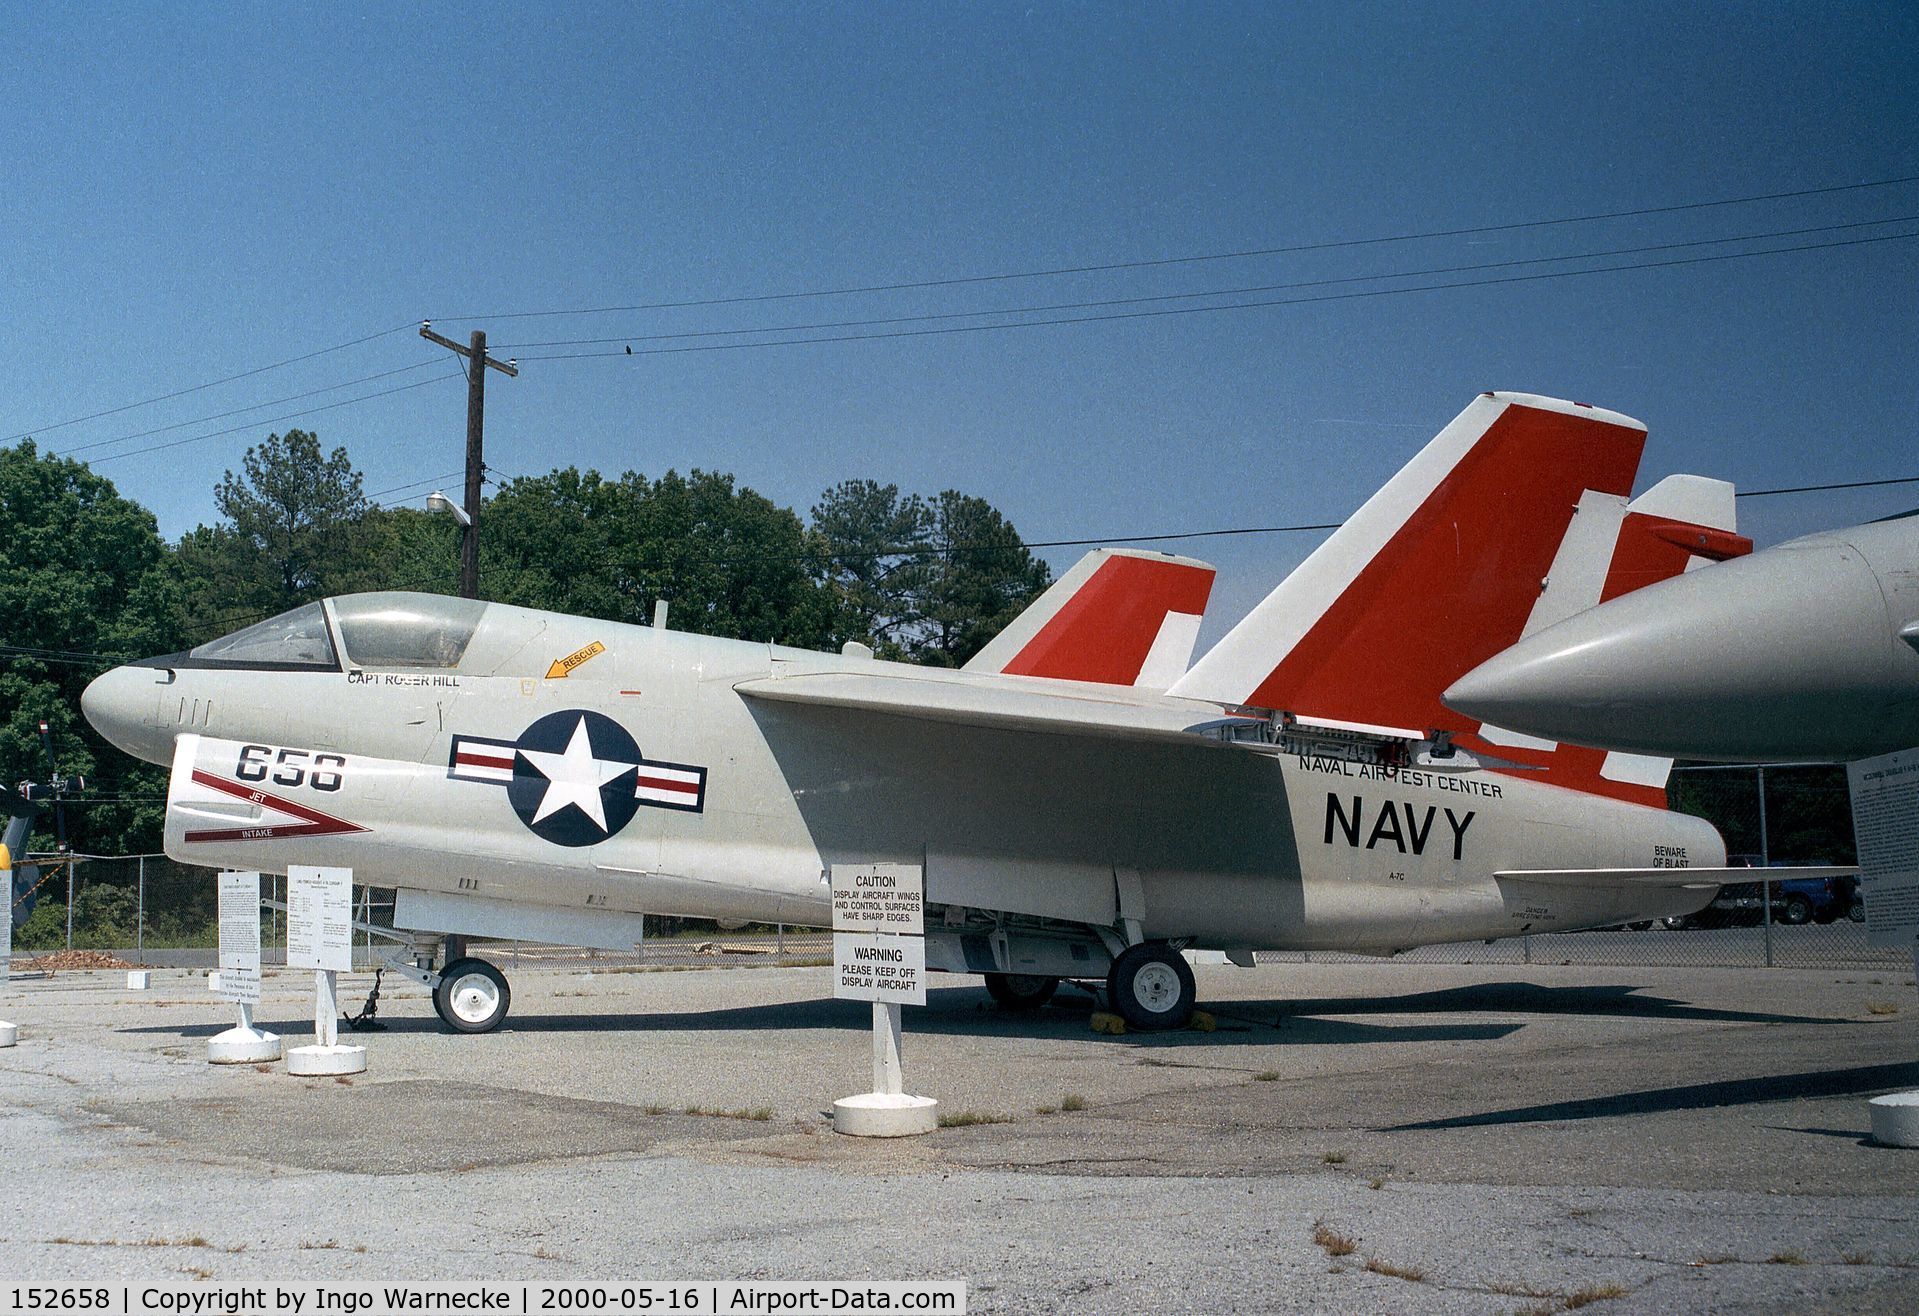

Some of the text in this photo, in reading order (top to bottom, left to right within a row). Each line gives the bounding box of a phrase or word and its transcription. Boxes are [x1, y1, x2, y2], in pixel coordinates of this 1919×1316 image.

[562, 645, 598, 670] RESCUE
[347, 674, 380, 686] CAPT
[433, 677, 460, 688] HILL
[1300, 755, 1353, 777] NAVAL
[1359, 765, 1386, 782] AIR
[1438, 776, 1503, 799] CENTER
[249, 791, 267, 804] JET
[1323, 792, 1476, 861] NAVY
[242, 829, 273, 839] INTAKE
[1654, 846, 1687, 858] BEWARE
[1652, 858, 1690, 869] OF BLAST
[855, 876, 896, 887] CAUTION
[1389, 872, 1405, 881] A-7C
[833, 890, 920, 901] DISPLAY AIRCRAFT WINGS
[834, 901, 920, 912] AND CONTROL SURFACES
[842, 912, 912, 922] HAVE SHARP EDGES.
[854, 947, 903, 962] WARNING
[842, 964, 916, 978] PLEASE KEEP OFF
[841, 977, 917, 991] DISPLAY AIRCRAFT
